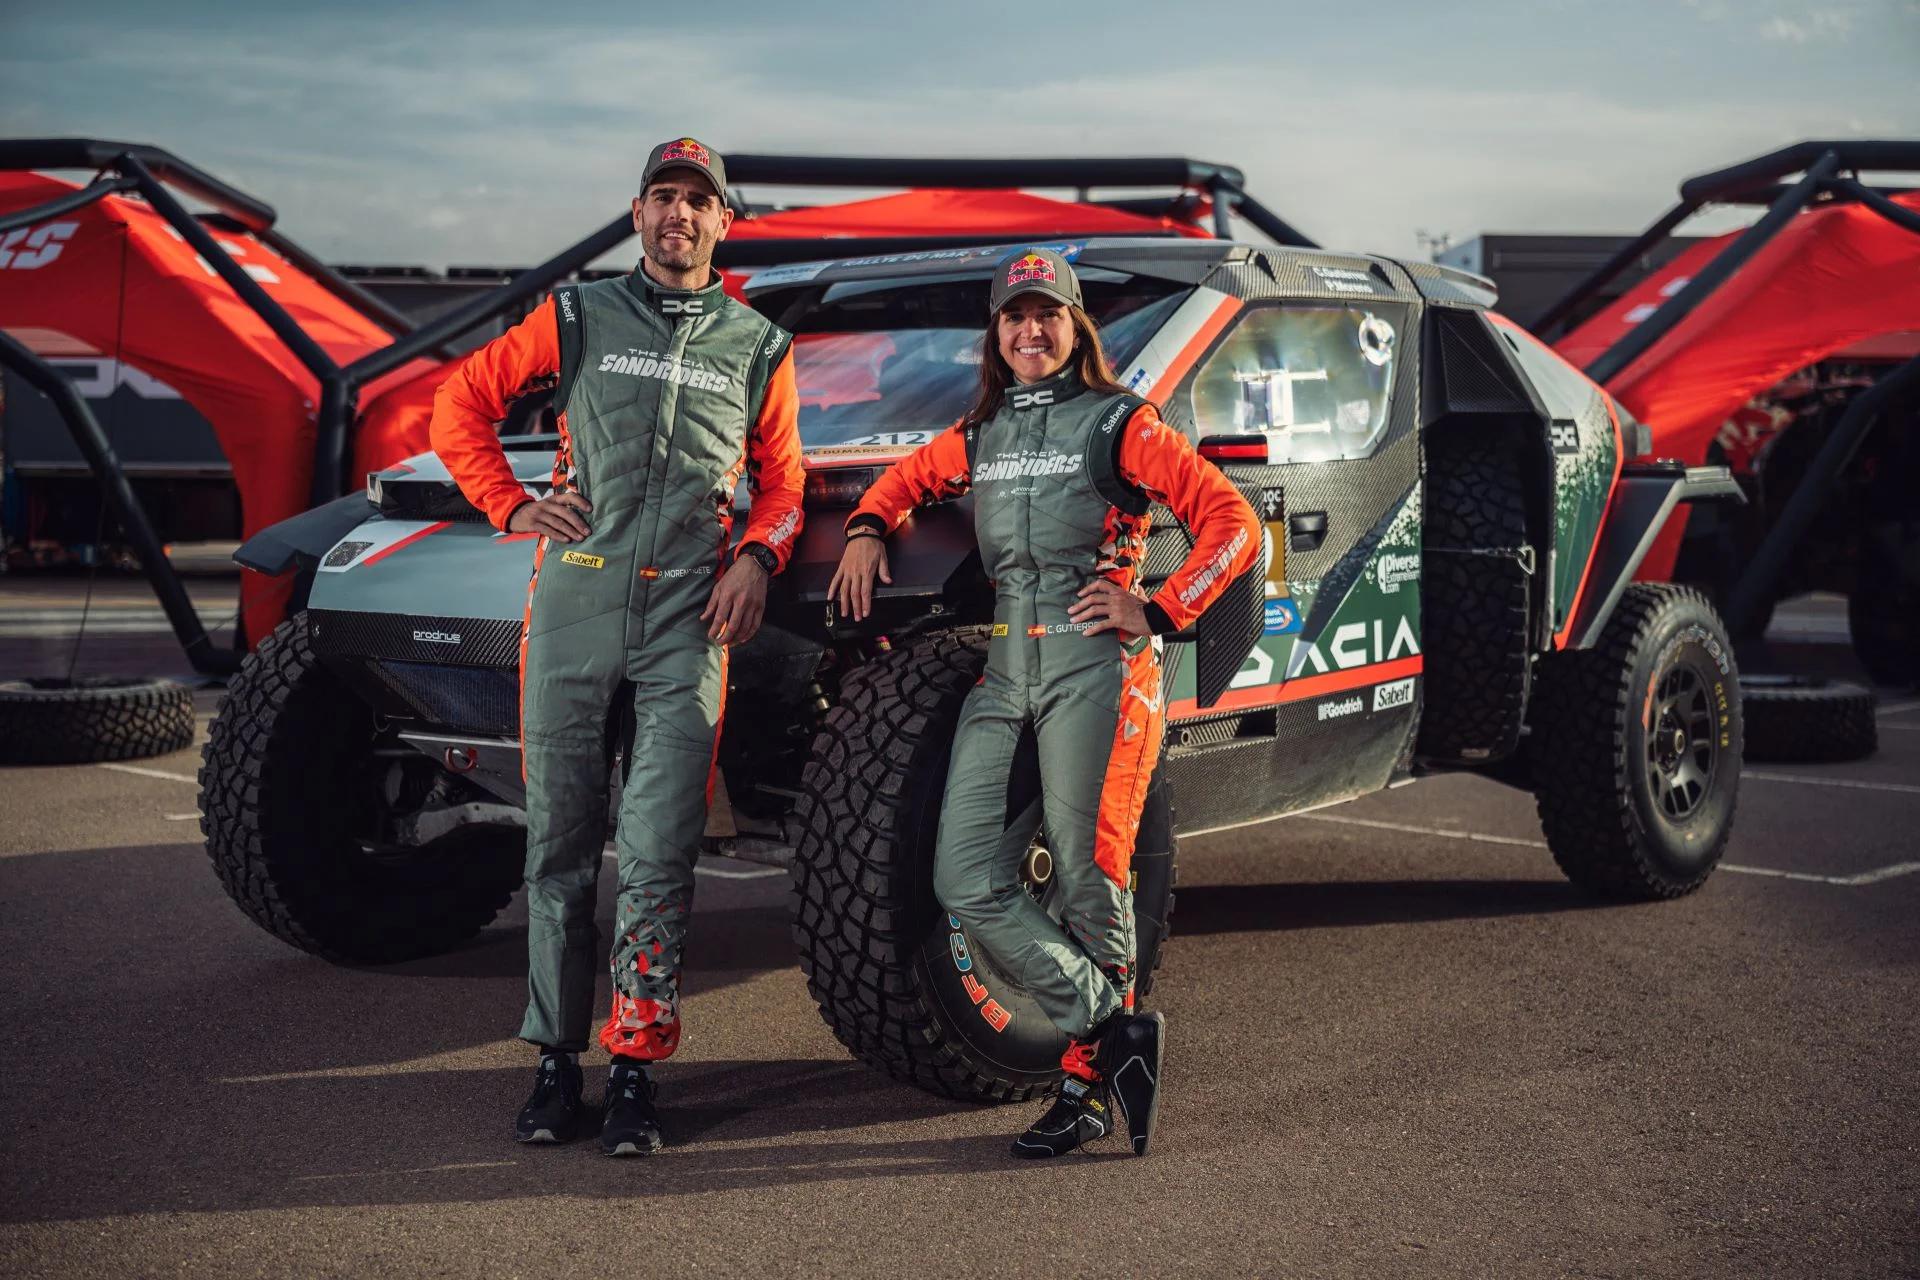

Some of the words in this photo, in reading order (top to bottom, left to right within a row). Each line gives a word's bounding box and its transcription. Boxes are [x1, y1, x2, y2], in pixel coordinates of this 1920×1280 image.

[661, 150, 686, 162] Red
[687, 150, 710, 168] Bull
[1008, 270, 1030, 287] Red
[1031, 269, 1055, 284] Bull
[560, 291, 576, 323] Sabelt
[628, 348, 659, 358] THE
[764, 329, 785, 359] Sabelt
[598, 353, 730, 393] SANDRIDERS
[1101, 402, 1129, 434] Sabelt
[860, 432, 926, 446] 212
[996, 452, 1018, 460] THE
[1021, 449, 1058, 459] DACIA
[566, 552, 600, 567] Sabelt
[1180, 526, 1248, 609] SANDRIDERS
[1385, 554, 1420, 572] Diverse
[1230, 614, 1421, 689] DACIA
[1378, 682, 1410, 707] Sabelt
[1317, 696, 1364, 721] BFGoodrich
